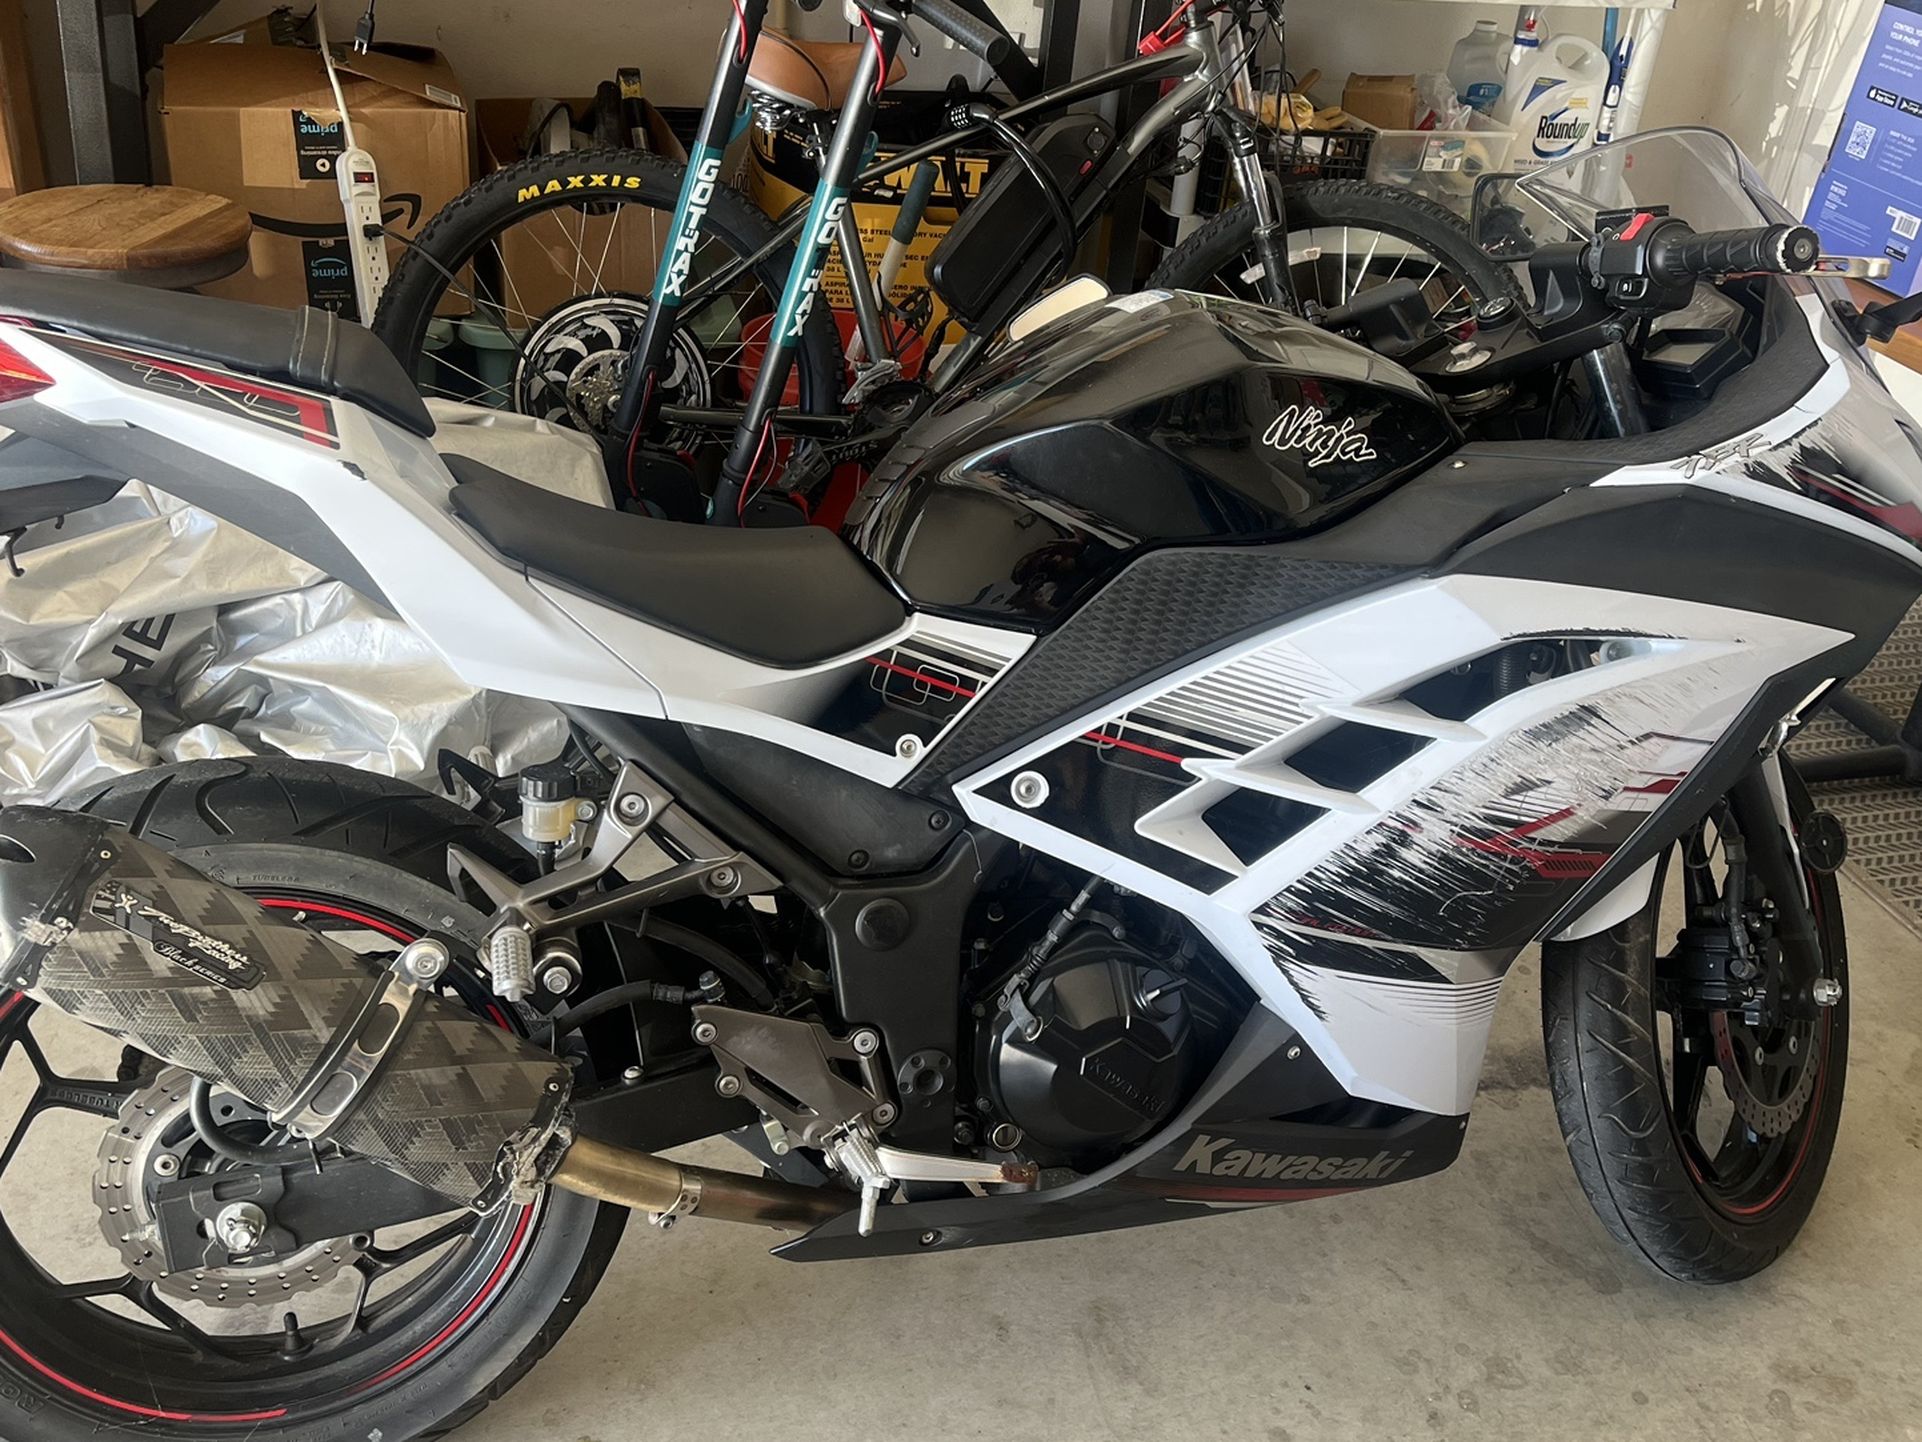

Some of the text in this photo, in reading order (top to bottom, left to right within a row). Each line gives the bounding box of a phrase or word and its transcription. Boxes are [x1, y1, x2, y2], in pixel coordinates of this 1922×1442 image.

[1536, 115, 1591, 143] Roundup
[517, 174, 642, 203] MAXXIS
[663, 158, 722, 297] GOTRAX
[311, 266, 348, 280] prime
[1262, 405, 1377, 468] Ninja
[154, 940, 199, 970] Black
[1172, 1133, 1416, 1180] Kawasaki
